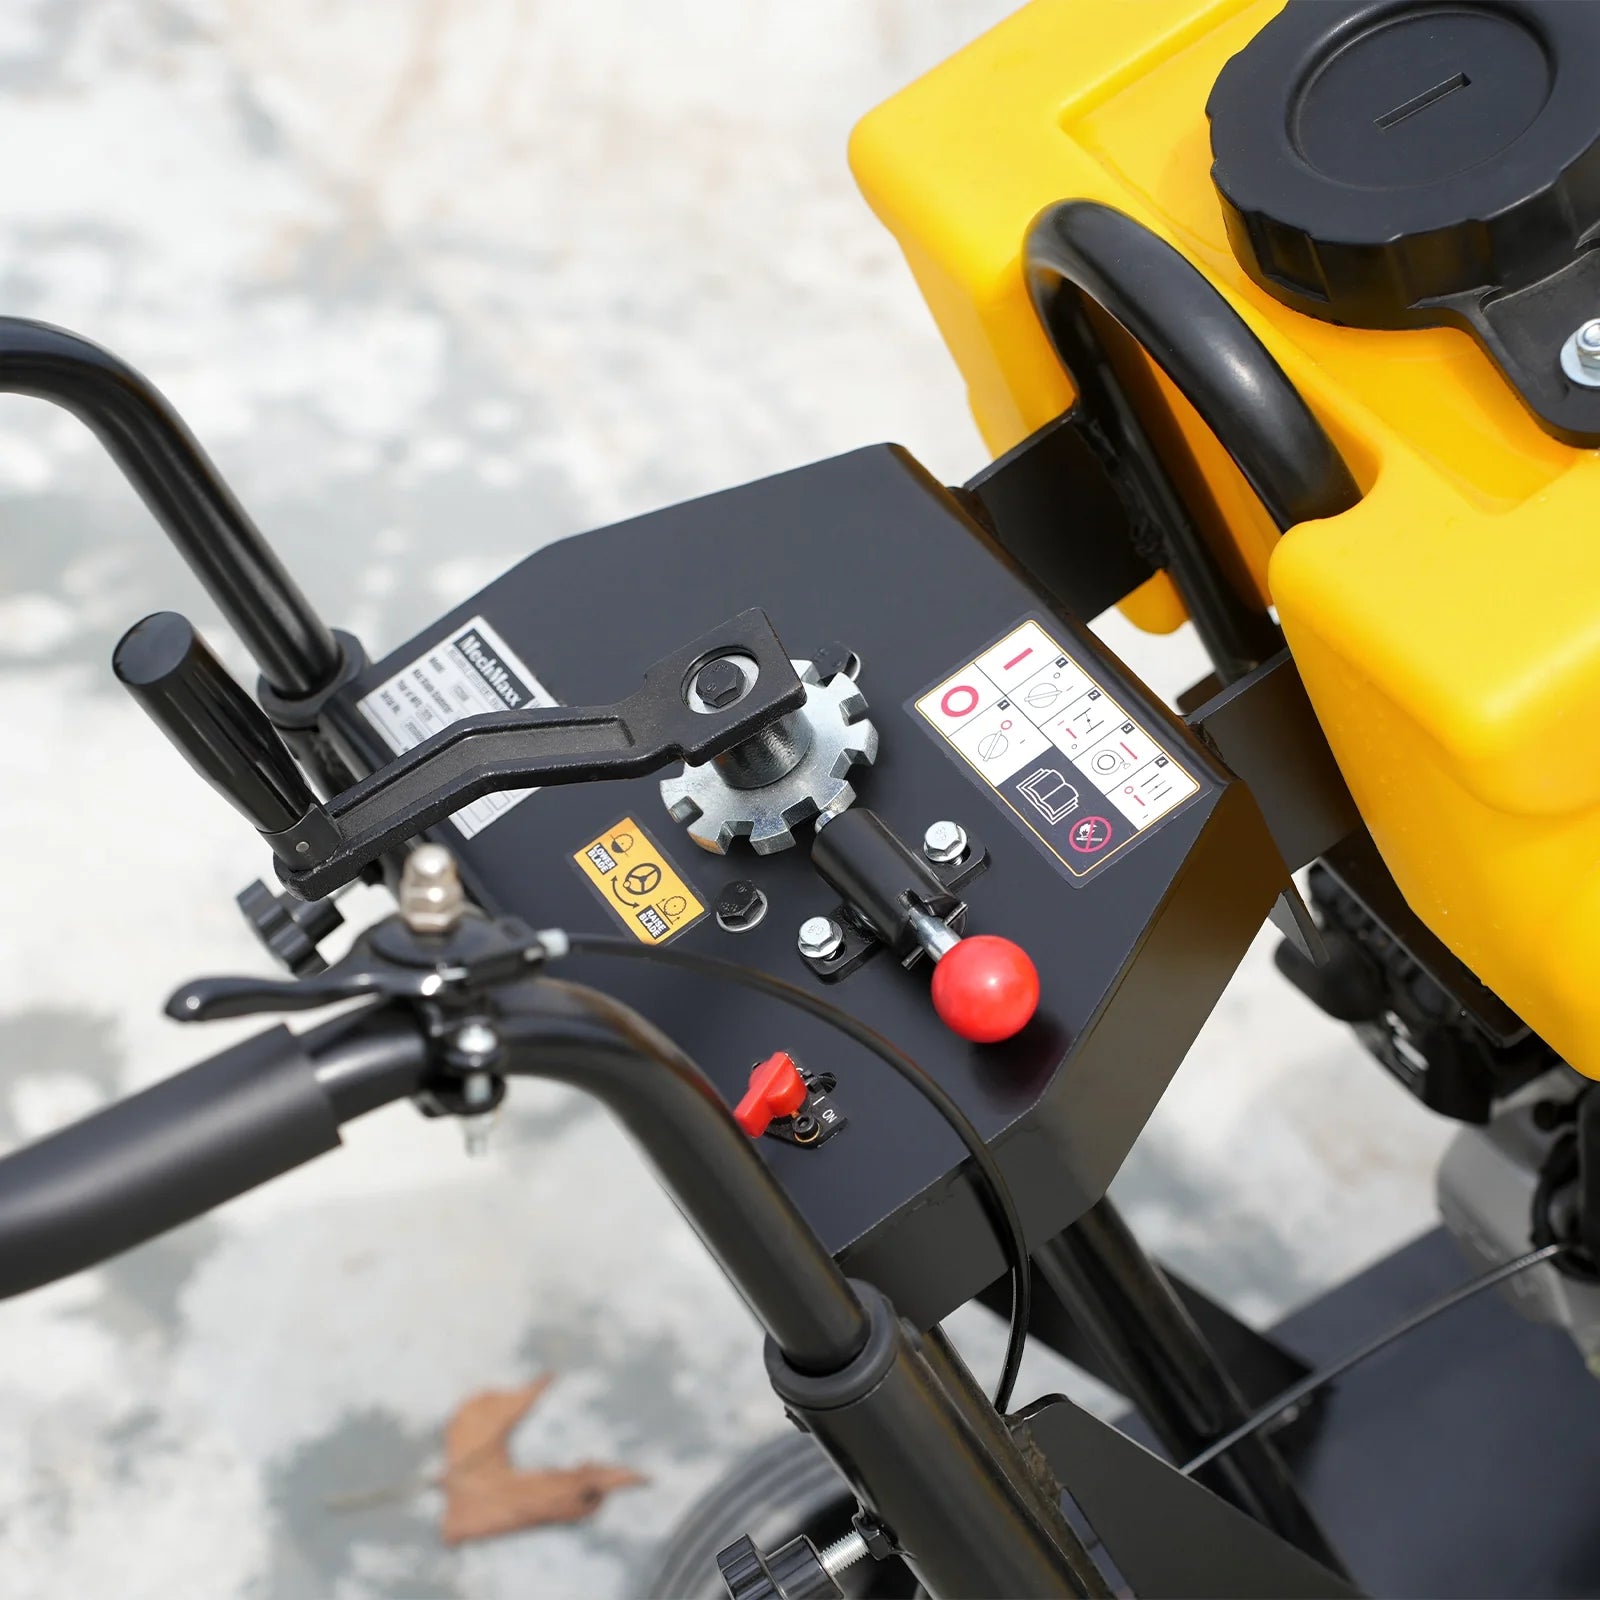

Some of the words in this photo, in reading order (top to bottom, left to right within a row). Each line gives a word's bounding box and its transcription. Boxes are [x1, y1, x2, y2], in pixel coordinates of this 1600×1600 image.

[459, 634, 522, 708] MechMaxx
[587, 849, 610, 874] BLADE
[593, 844, 616, 870] LOWER
[638, 913, 661, 938] BLADE
[645, 909, 667, 932] RAISE
[822, 1109, 838, 1124] ON
